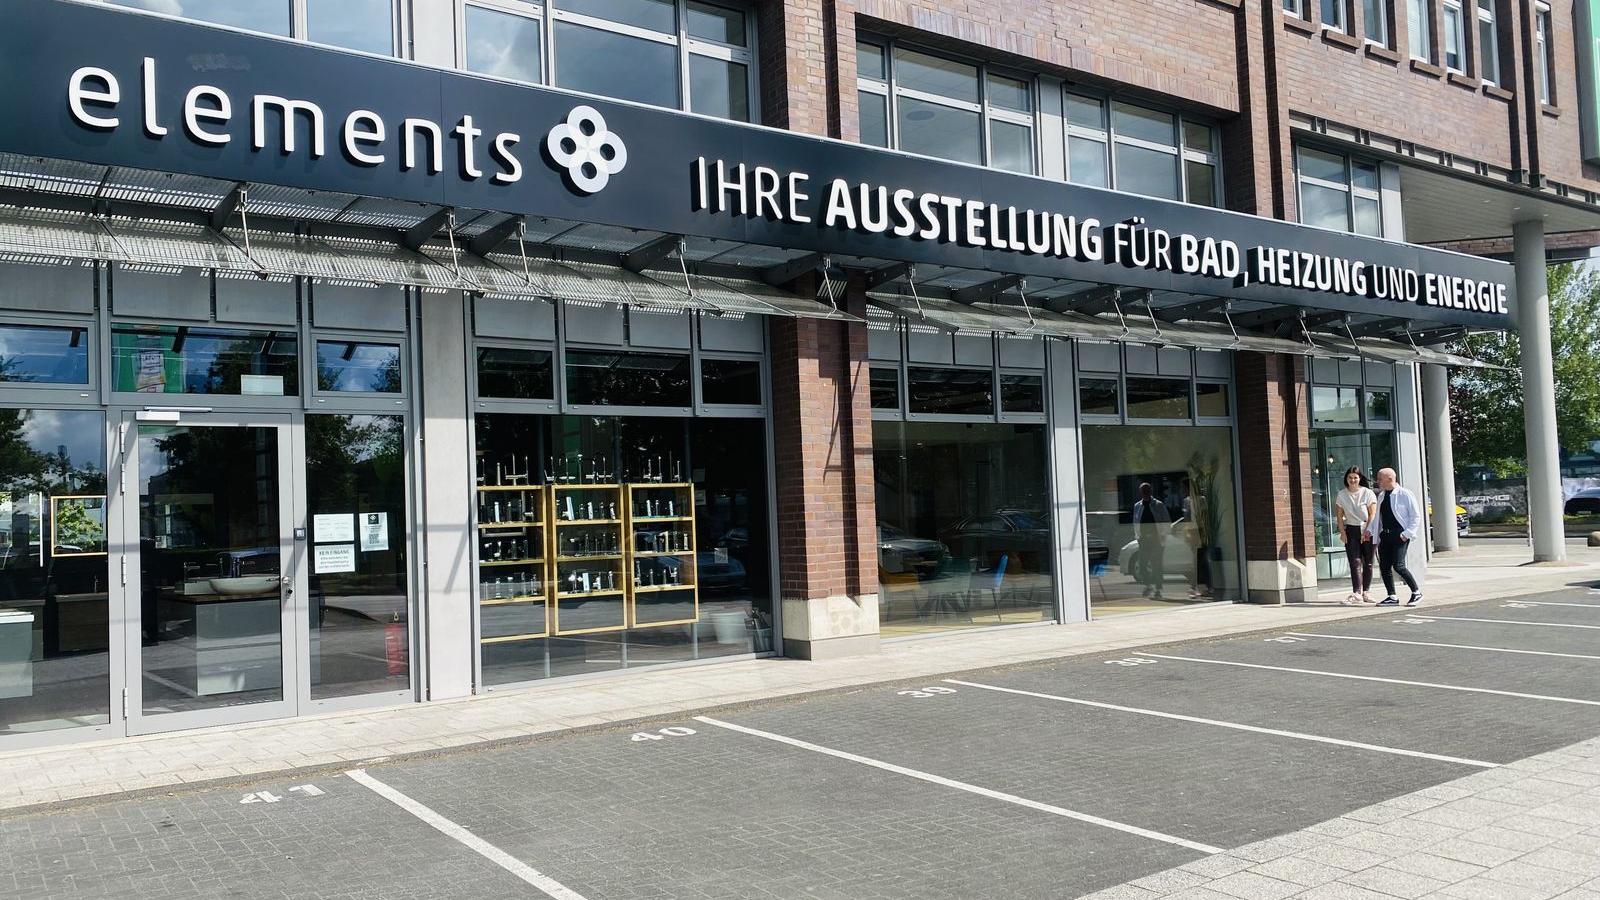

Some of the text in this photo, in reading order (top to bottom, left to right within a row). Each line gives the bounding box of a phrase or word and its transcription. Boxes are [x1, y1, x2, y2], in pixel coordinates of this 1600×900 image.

[69, 57, 522, 181] elements
[699, 157, 1508, 314] IHRE AUSSTELLUNG FÜR BAD, HEIZUNG UND ENERGIE
[1474, 494, 1510, 502] AMG
[1103, 658, 1159, 667] 38
[896, 686, 958, 699] 39
[629, 726, 698, 743] 40
[239, 783, 327, 805] 41
